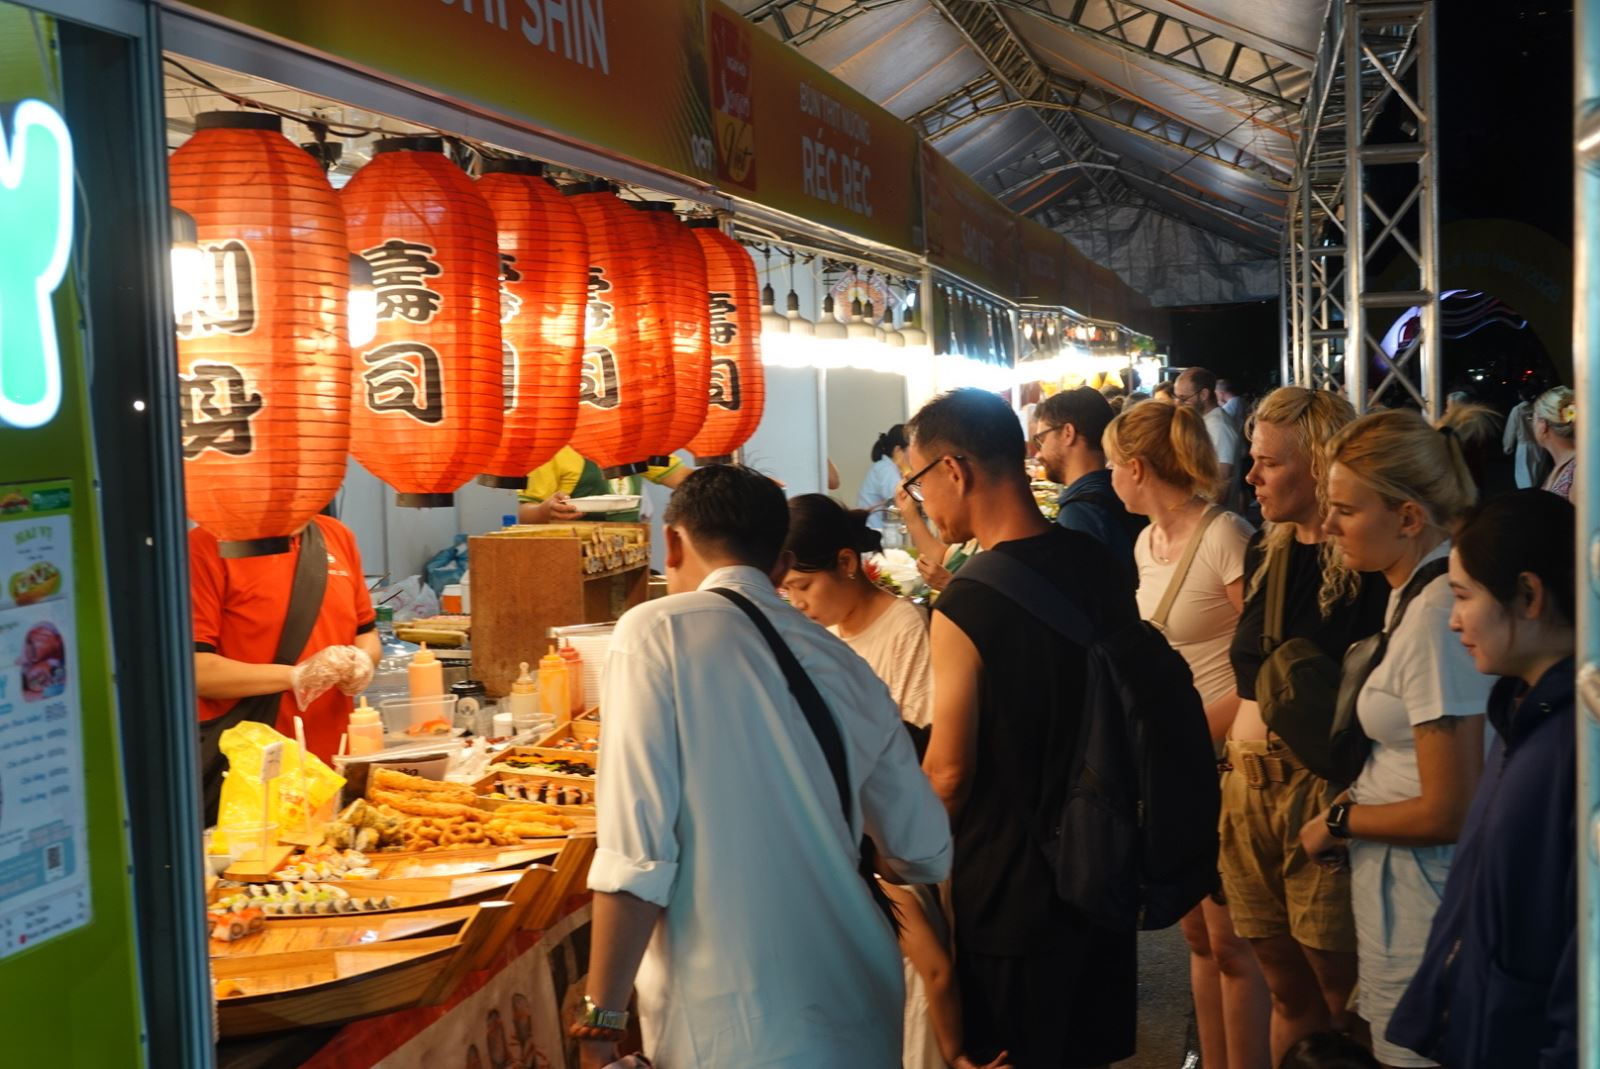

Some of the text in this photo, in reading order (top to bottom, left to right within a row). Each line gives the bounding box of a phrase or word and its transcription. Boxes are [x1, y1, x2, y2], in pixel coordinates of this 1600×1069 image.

[521, 0, 609, 75] SHIN
[802, 127, 873, 218] RÉC RÉC
